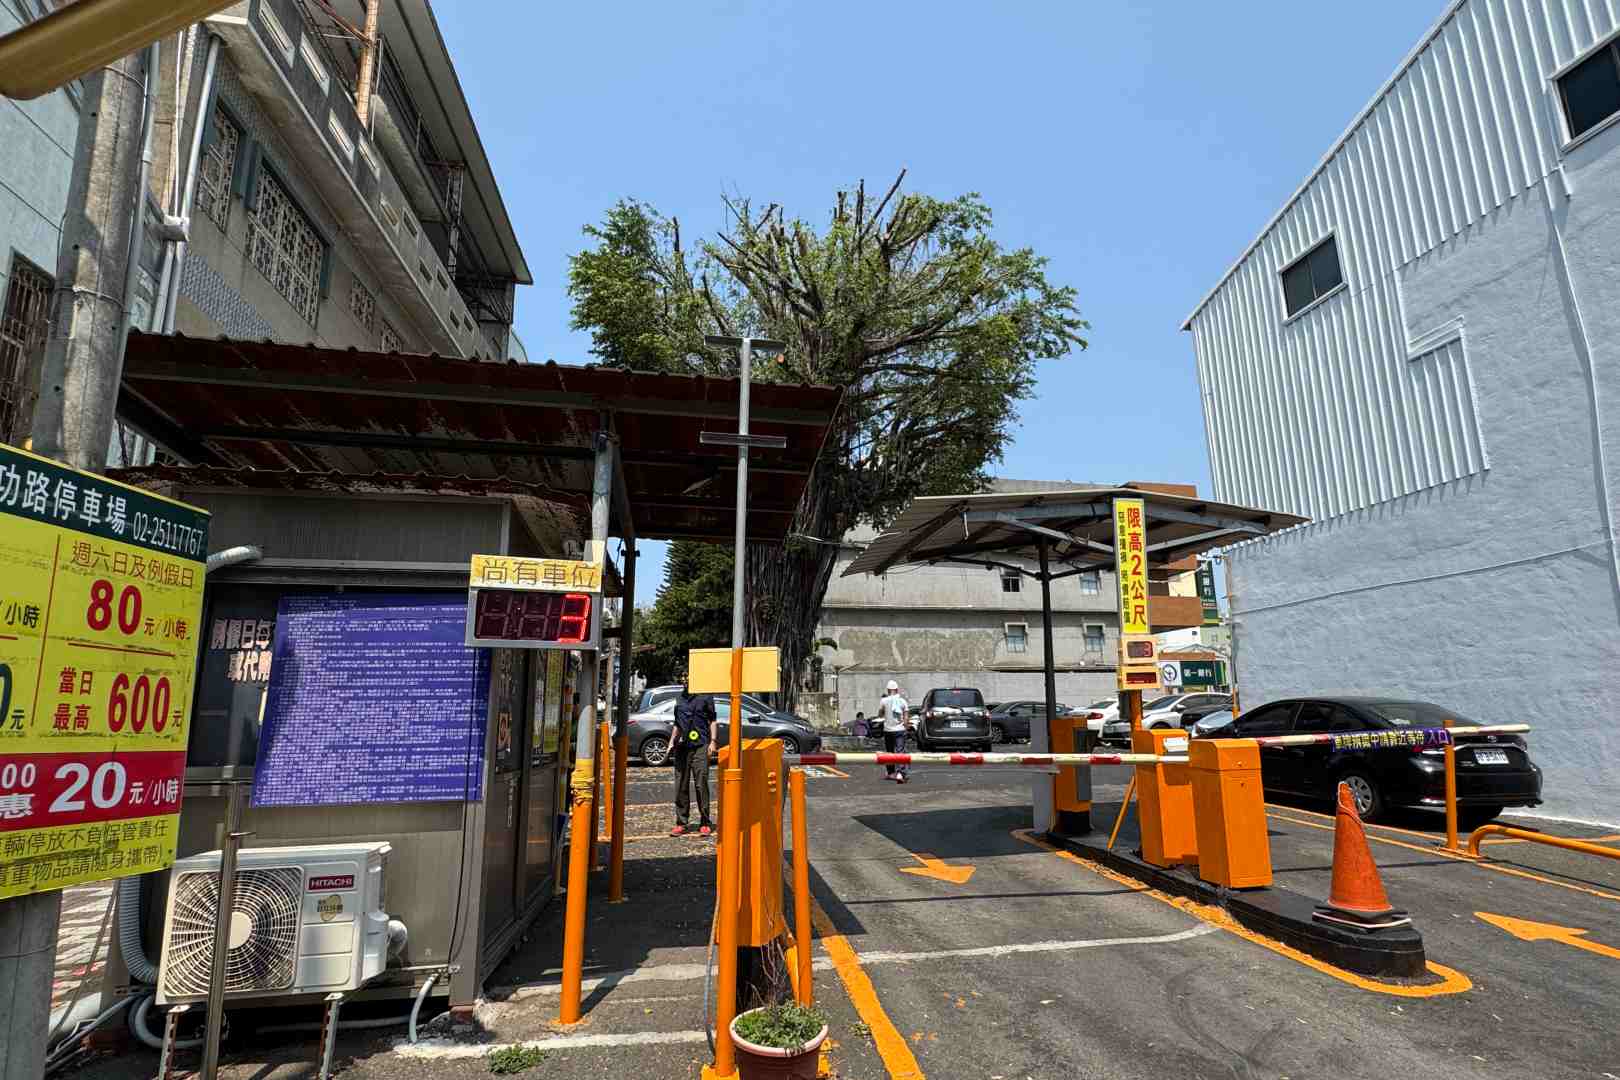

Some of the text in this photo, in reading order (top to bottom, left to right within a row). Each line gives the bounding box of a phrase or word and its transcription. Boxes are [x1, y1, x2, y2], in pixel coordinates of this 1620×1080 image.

[0, 463, 204, 556] 功路停車場 02-25117767
[70, 540, 194, 589] 週六日及例假日
[482, 559, 597, 588] 尚有車位
[1127, 506, 1146, 626] 限高2公尺
[0, 600, 40, 629] 小時
[86, 578, 142, 635] 80
[59, 666, 93, 695] 當日
[10, 709, 25, 730] 元
[53, 703, 91, 731] 最高
[108, 672, 183, 734] 600 元
[48, 761, 179, 813] 20 元/小時
[0, 819, 169, 858] 輛停放不負保管責任
[311, 878, 353, 889] HITACHI
